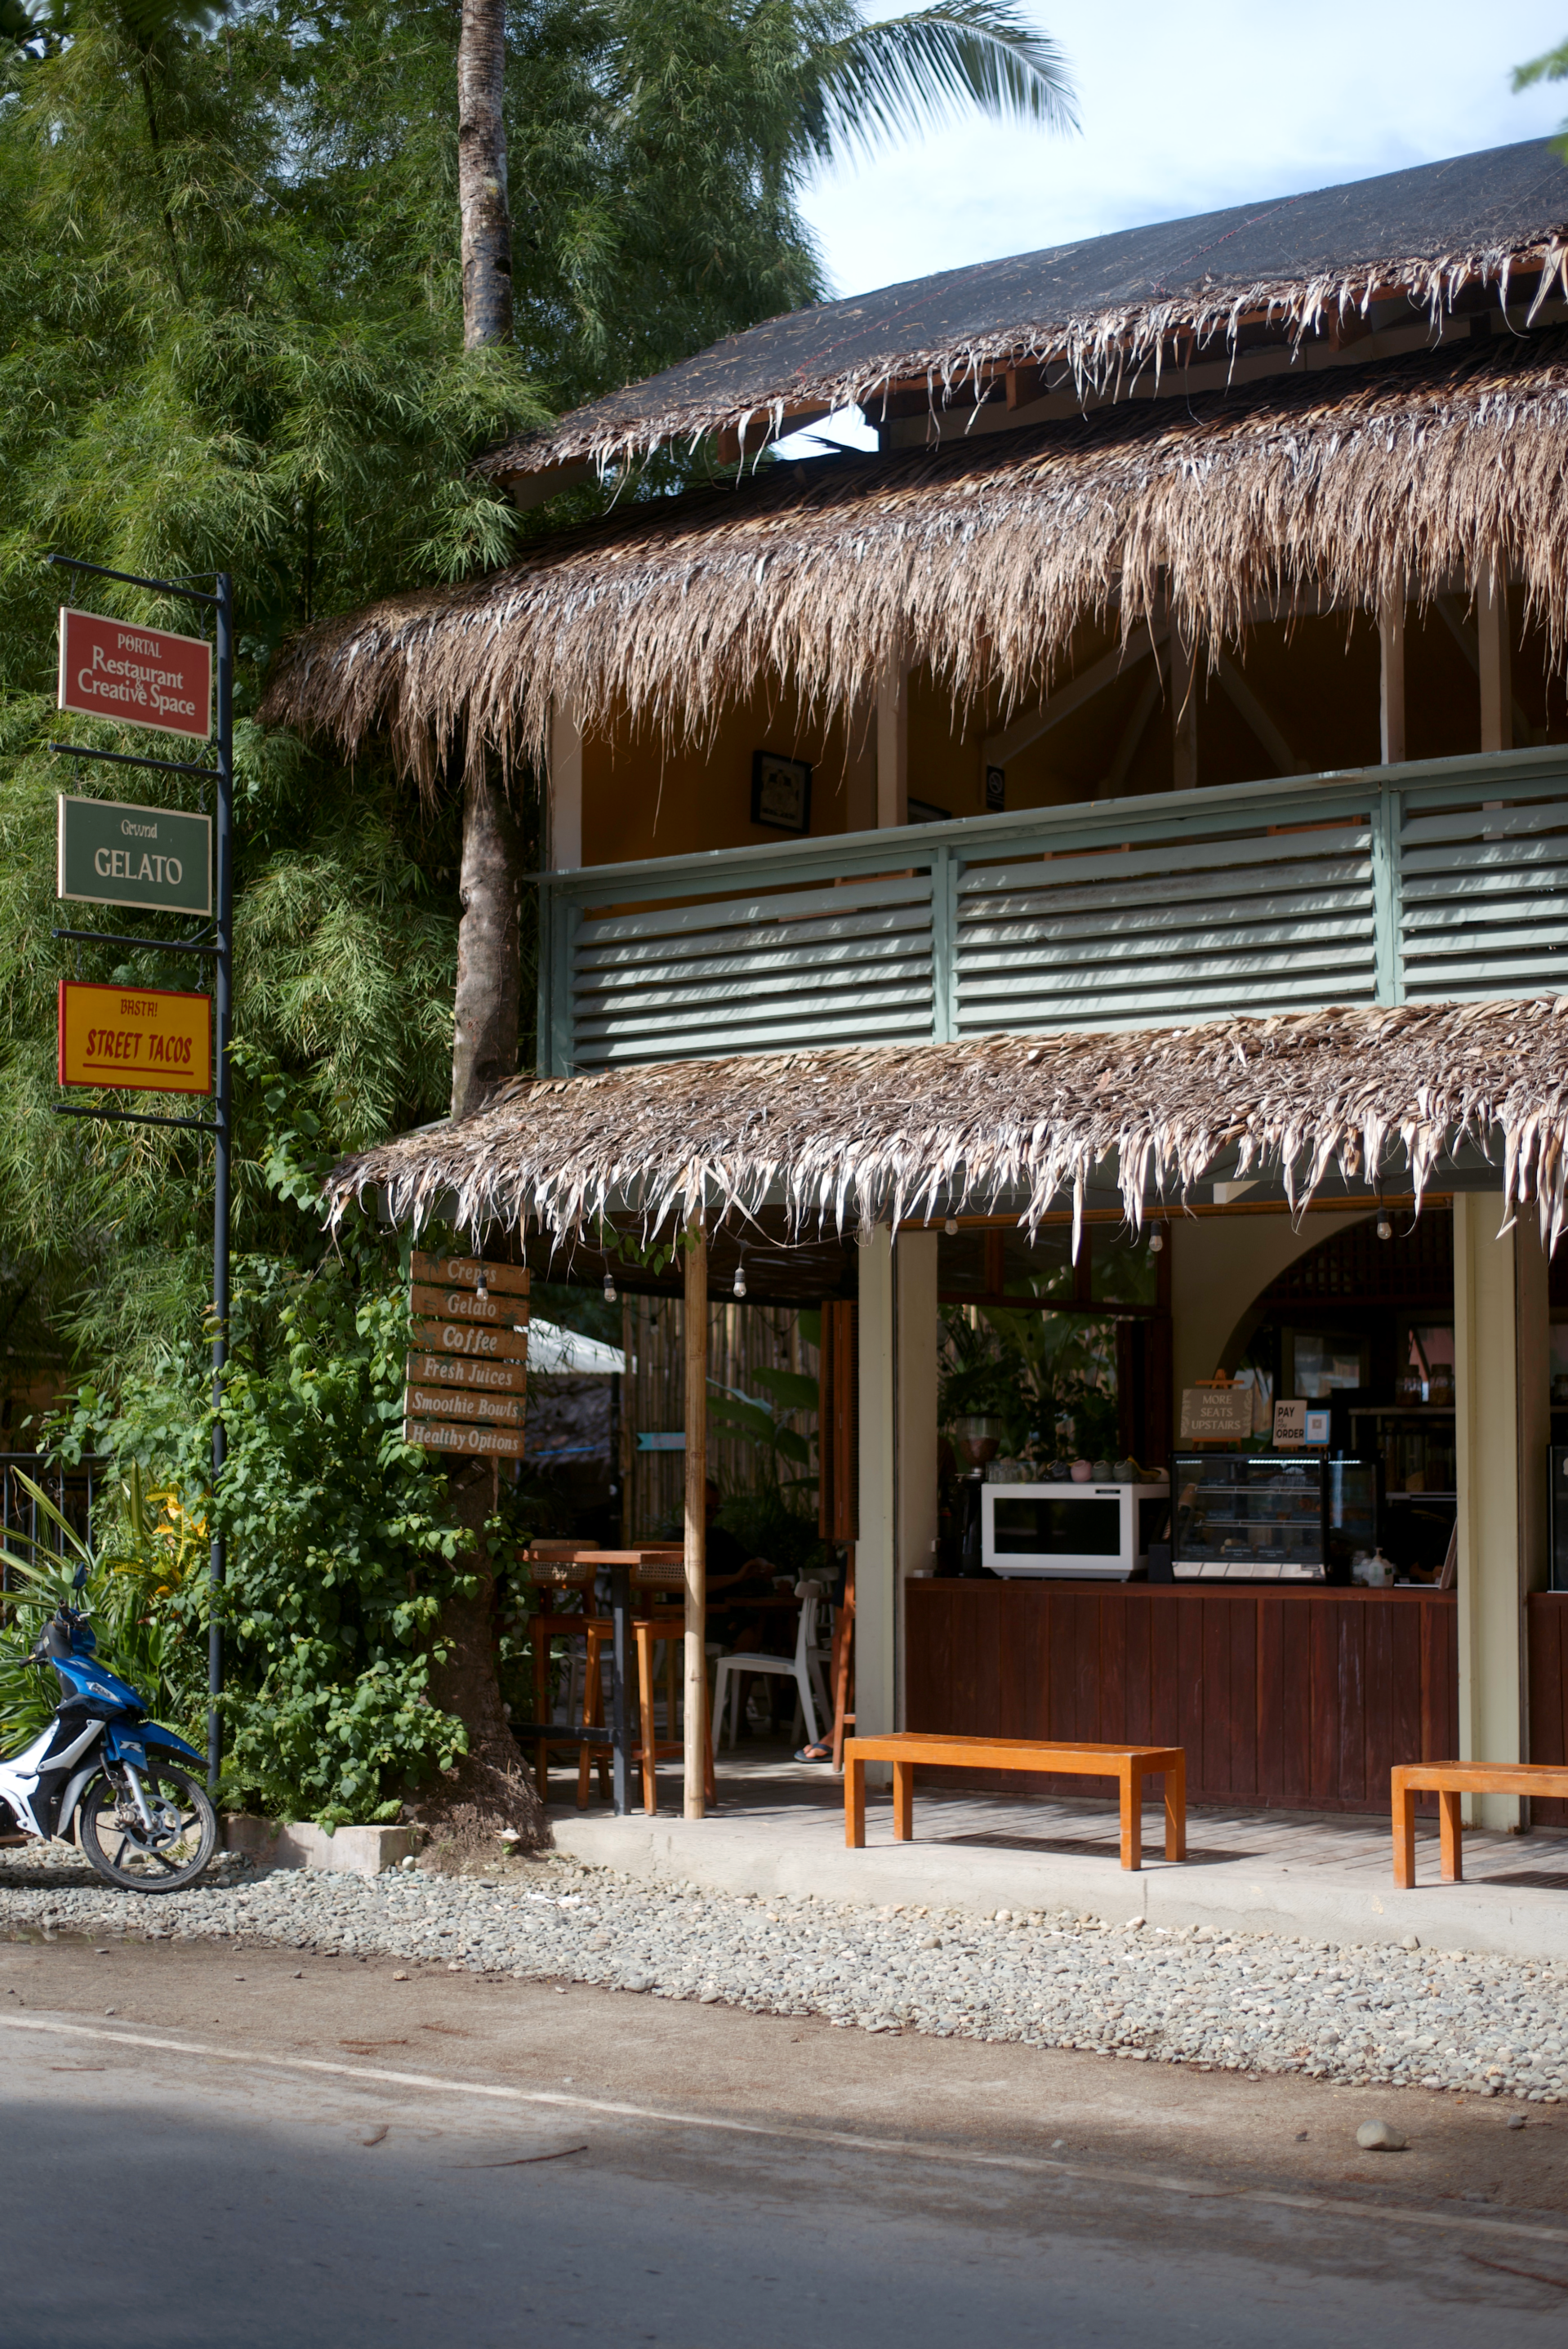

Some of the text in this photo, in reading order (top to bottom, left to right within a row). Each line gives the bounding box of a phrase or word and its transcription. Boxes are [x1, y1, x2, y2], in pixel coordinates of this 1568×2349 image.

[118, 633, 162, 658] PORTAL
[92, 645, 184, 690] Restaurant
[78, 668, 195, 715] Creative Space
[135, 677, 145, 692] &
[94, 848, 183, 885] GELATO
[121, 999, 158, 1018] BASTA!
[86, 1028, 193, 1064] STREET TACOS
[448, 1260, 497, 1285] Crepes
[448, 1294, 497, 1317] Gelato
[443, 1326, 498, 1353] Coffee
[423, 1357, 513, 1386] Fresh Juices
[412, 1391, 519, 1419] Smoothie Bowls
[1200, 1407, 1233, 1417] SEATS
[1202, 1395, 1232, 1405] MORE
[1278, 1406, 1295, 1418] PAY
[1192, 1420, 1241, 1430] UPSTAIRS
[1276, 1429, 1304, 1439] ORDER
[412, 1424, 519, 1452] Healthy Options
